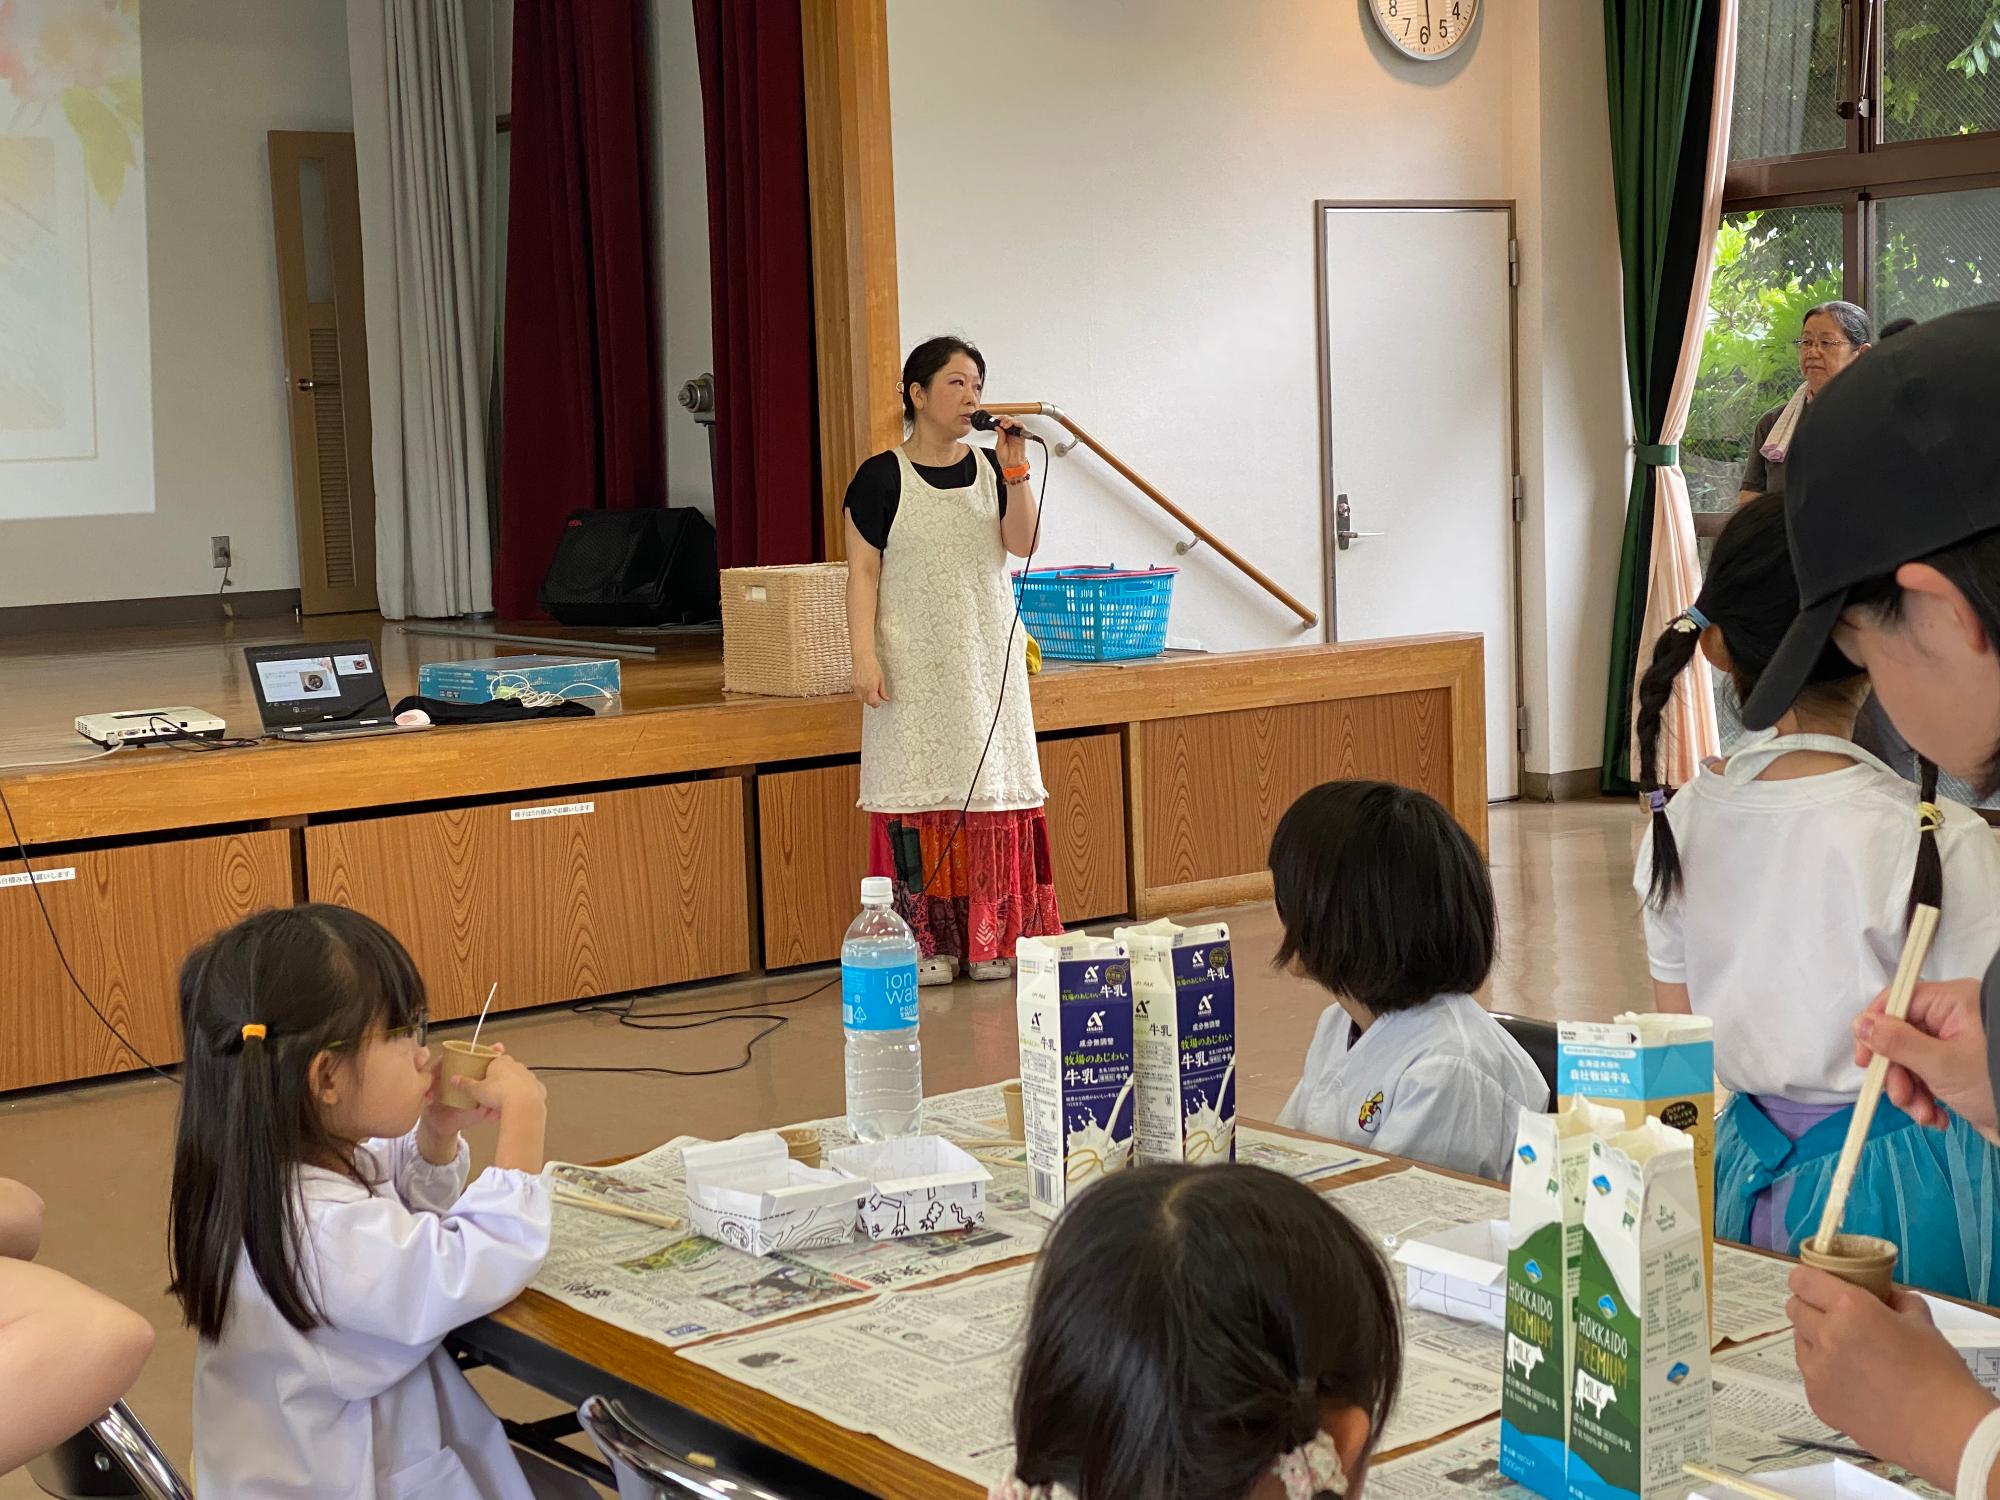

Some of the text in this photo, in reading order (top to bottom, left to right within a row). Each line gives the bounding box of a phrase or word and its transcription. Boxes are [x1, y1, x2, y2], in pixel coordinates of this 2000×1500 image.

[1452, 2, 1460, 20] 4
[1402, 18, 1411, 36] 7
[1420, 26, 1430, 45] 6
[1439, 19, 1448, 38] 5
[885, 970, 912, 990] ion
[1207, 967, 1230, 982] 牛乳
[1100, 984, 1128, 999] 牛乳
[1149, 1022, 1172, 1037] 牛乳
[1041, 1036, 1057, 1051] 牛乳
[1079, 1037, 1115, 1048] 成分無調整
[1181, 1034, 1232, 1051] 牧場のあじわい
[1064, 1051, 1129, 1066] 牧場のあじわい
[1180, 1050, 1209, 1070] 牛乳
[1064, 1067, 1098, 1087] 牛乳
[1508, 1278, 1553, 1321] HOKKAIDO
[1507, 1299, 1553, 1351] PREMIUM
[1579, 1312, 1628, 1360] HOKKAIDO
[1514, 1341, 1532, 1360] MILK
[1578, 1332, 1628, 1391] PREMIUM
[1583, 1376, 1602, 1401] MILK
